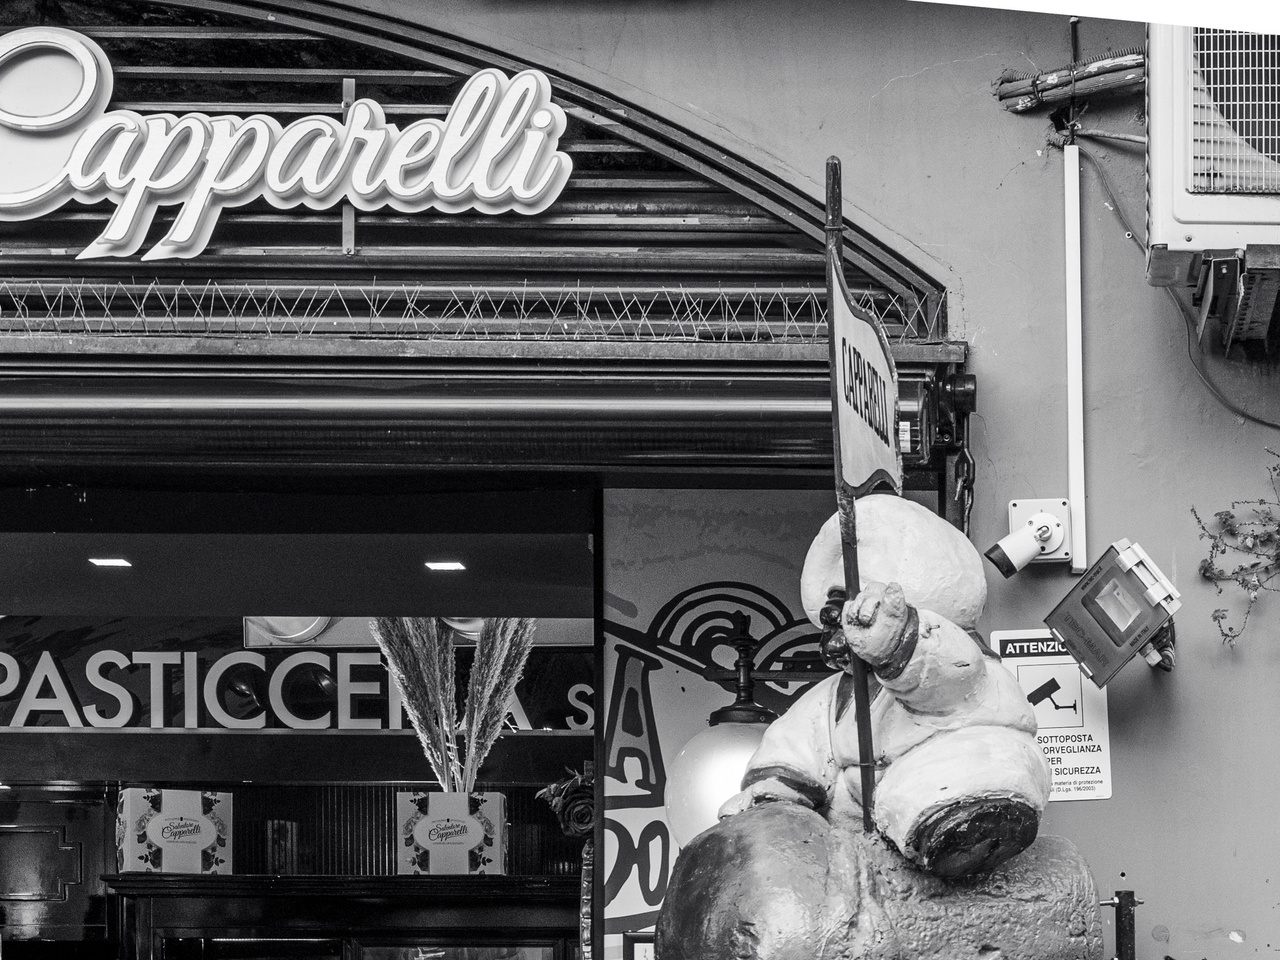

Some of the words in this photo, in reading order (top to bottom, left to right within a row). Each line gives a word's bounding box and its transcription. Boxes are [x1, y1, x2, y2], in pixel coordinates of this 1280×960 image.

[1037, 734, 1093, 744] SOTTOPOSTA
[1042, 745, 1102, 755] ORVEGLIANZA
[1054, 767, 1101, 776] SICUREZZA
[162, 825, 201, 840] Capparelli
[429, 825, 468, 841] Capparelli
